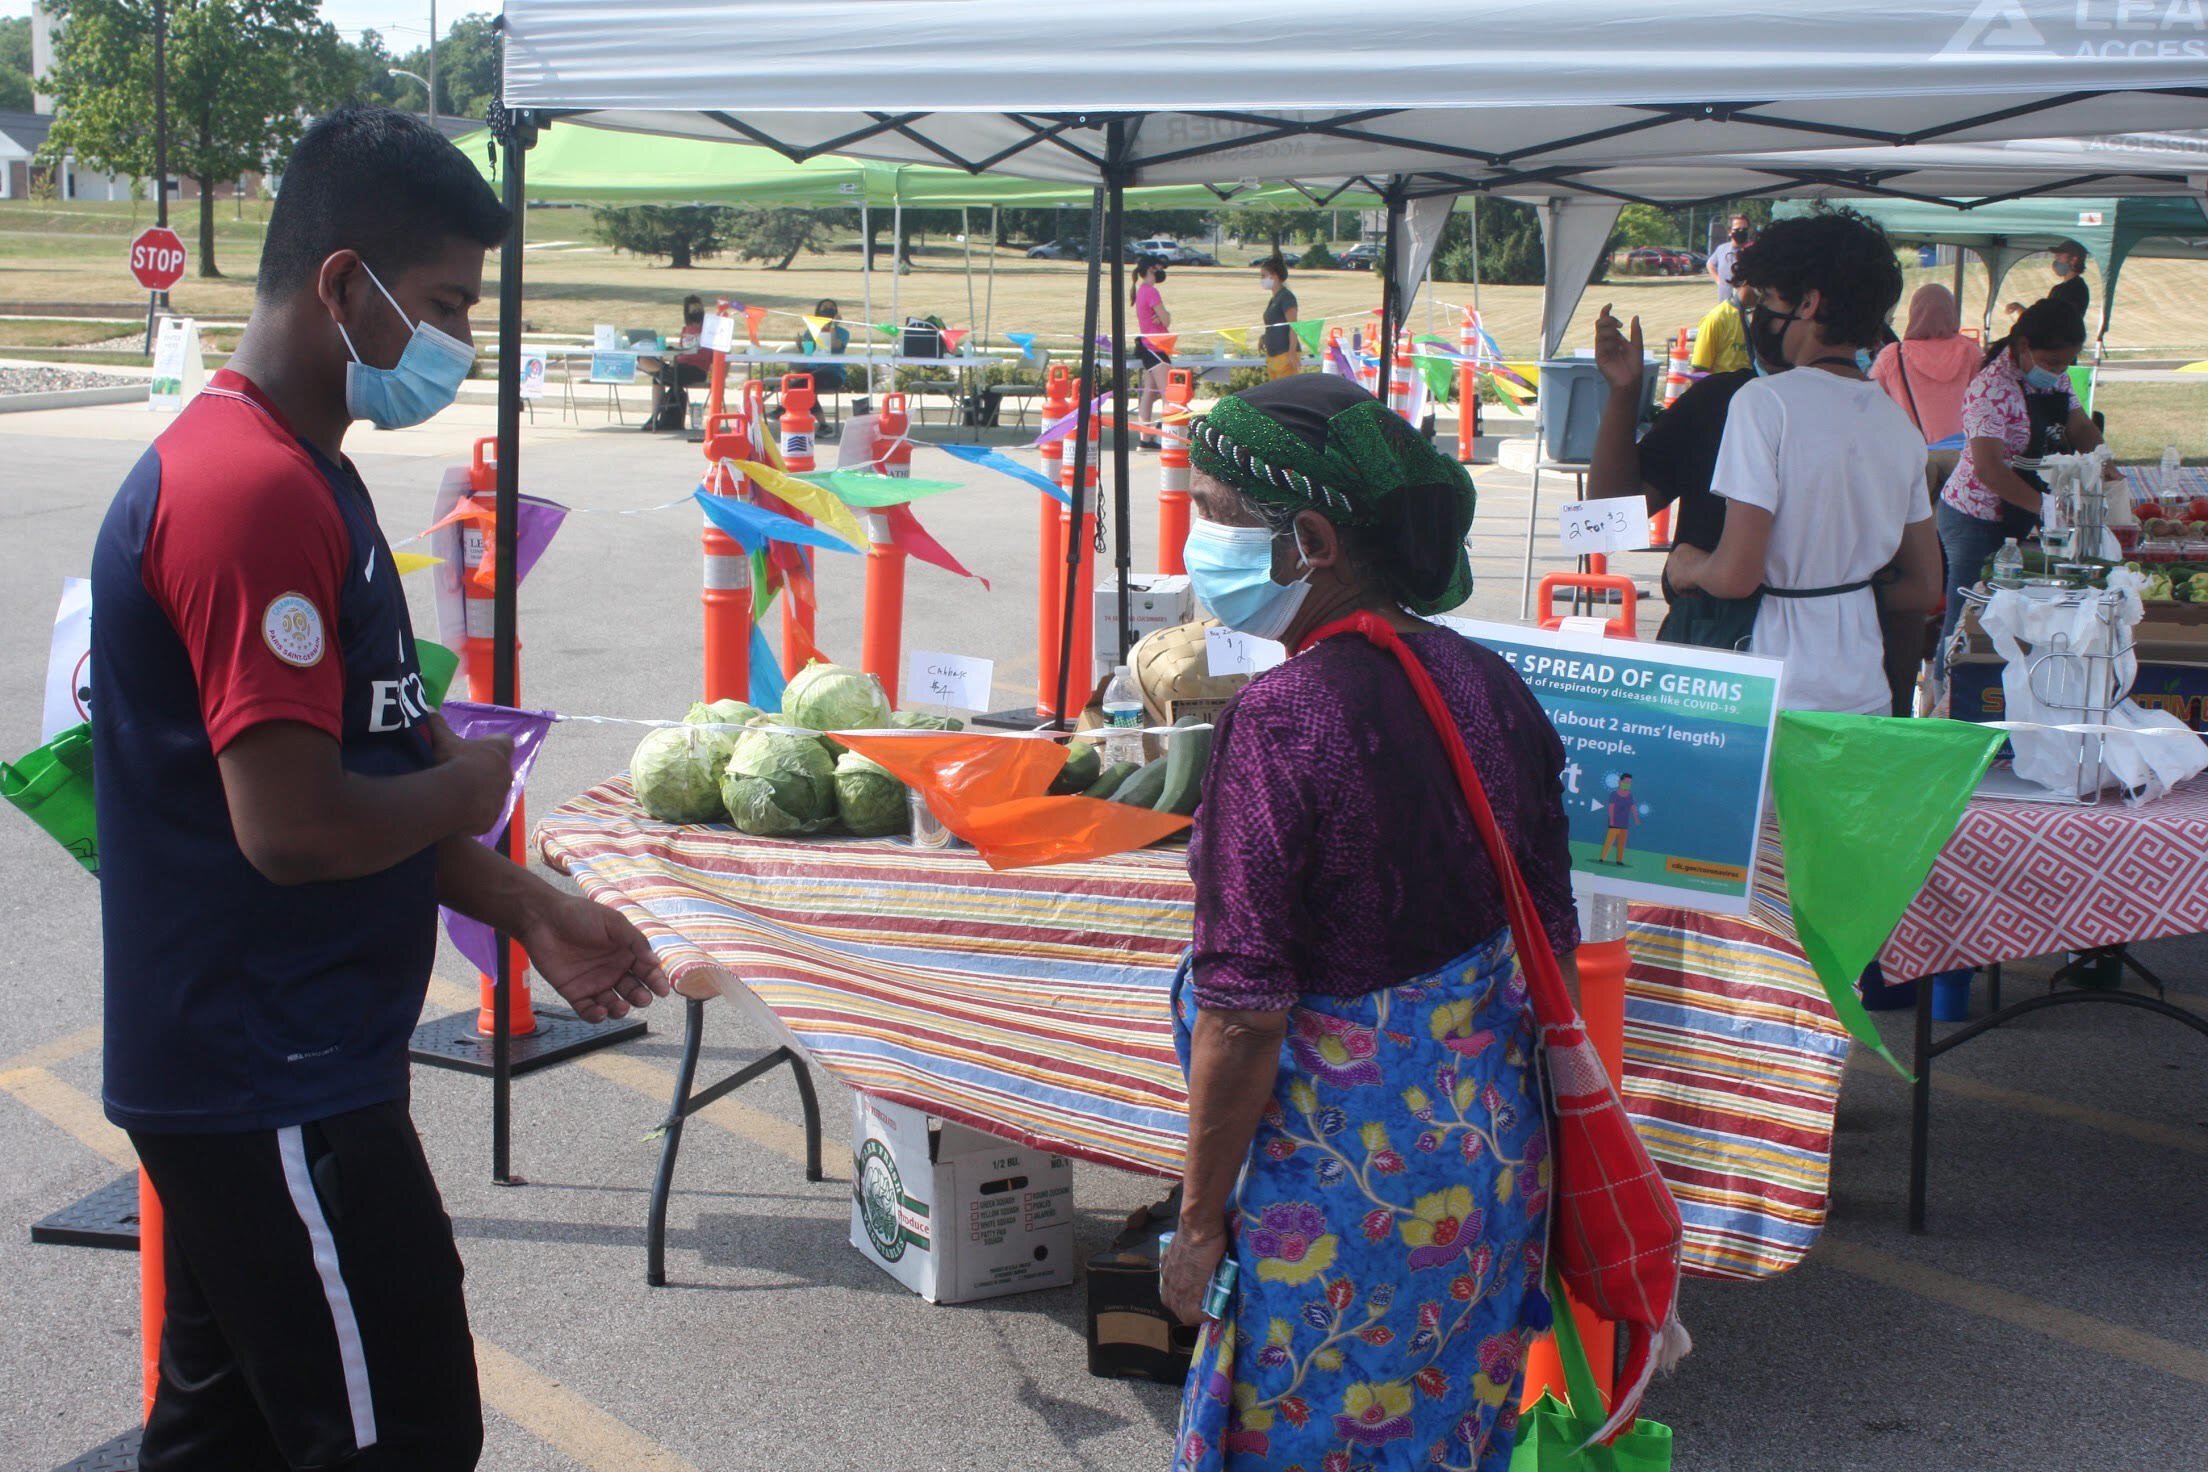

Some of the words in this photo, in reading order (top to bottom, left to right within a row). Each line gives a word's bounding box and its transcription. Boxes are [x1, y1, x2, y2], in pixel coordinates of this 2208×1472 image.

[2075, 0, 2207, 31] LEA
[2074, 39, 2206, 58] ACCES
[133, 245, 183, 273] STOP
[1569, 522, 1582, 540] 2
[268, 629, 284, 651] PARIS
[1523, 654, 1615, 683] SPREAD
[1621, 668, 1654, 688] OF
[1659, 674, 1742, 701] GERMS
[1535, 678, 1549, 687] of
[1549, 681, 1609, 698] respiratory
[1611, 688, 1658, 704] diseases
[1660, 694, 1680, 707] like
[1682, 698, 1740, 715] COVID-19.
[1553, 709, 1606, 729] (about
[1608, 718, 1619, 731] 2
[1667, 725, 1727, 748] length)
[1576, 738, 1636, 755] people.
[992, 1159, 1005, 1169] 1/2
[897, 1210, 930, 1234] Produce
